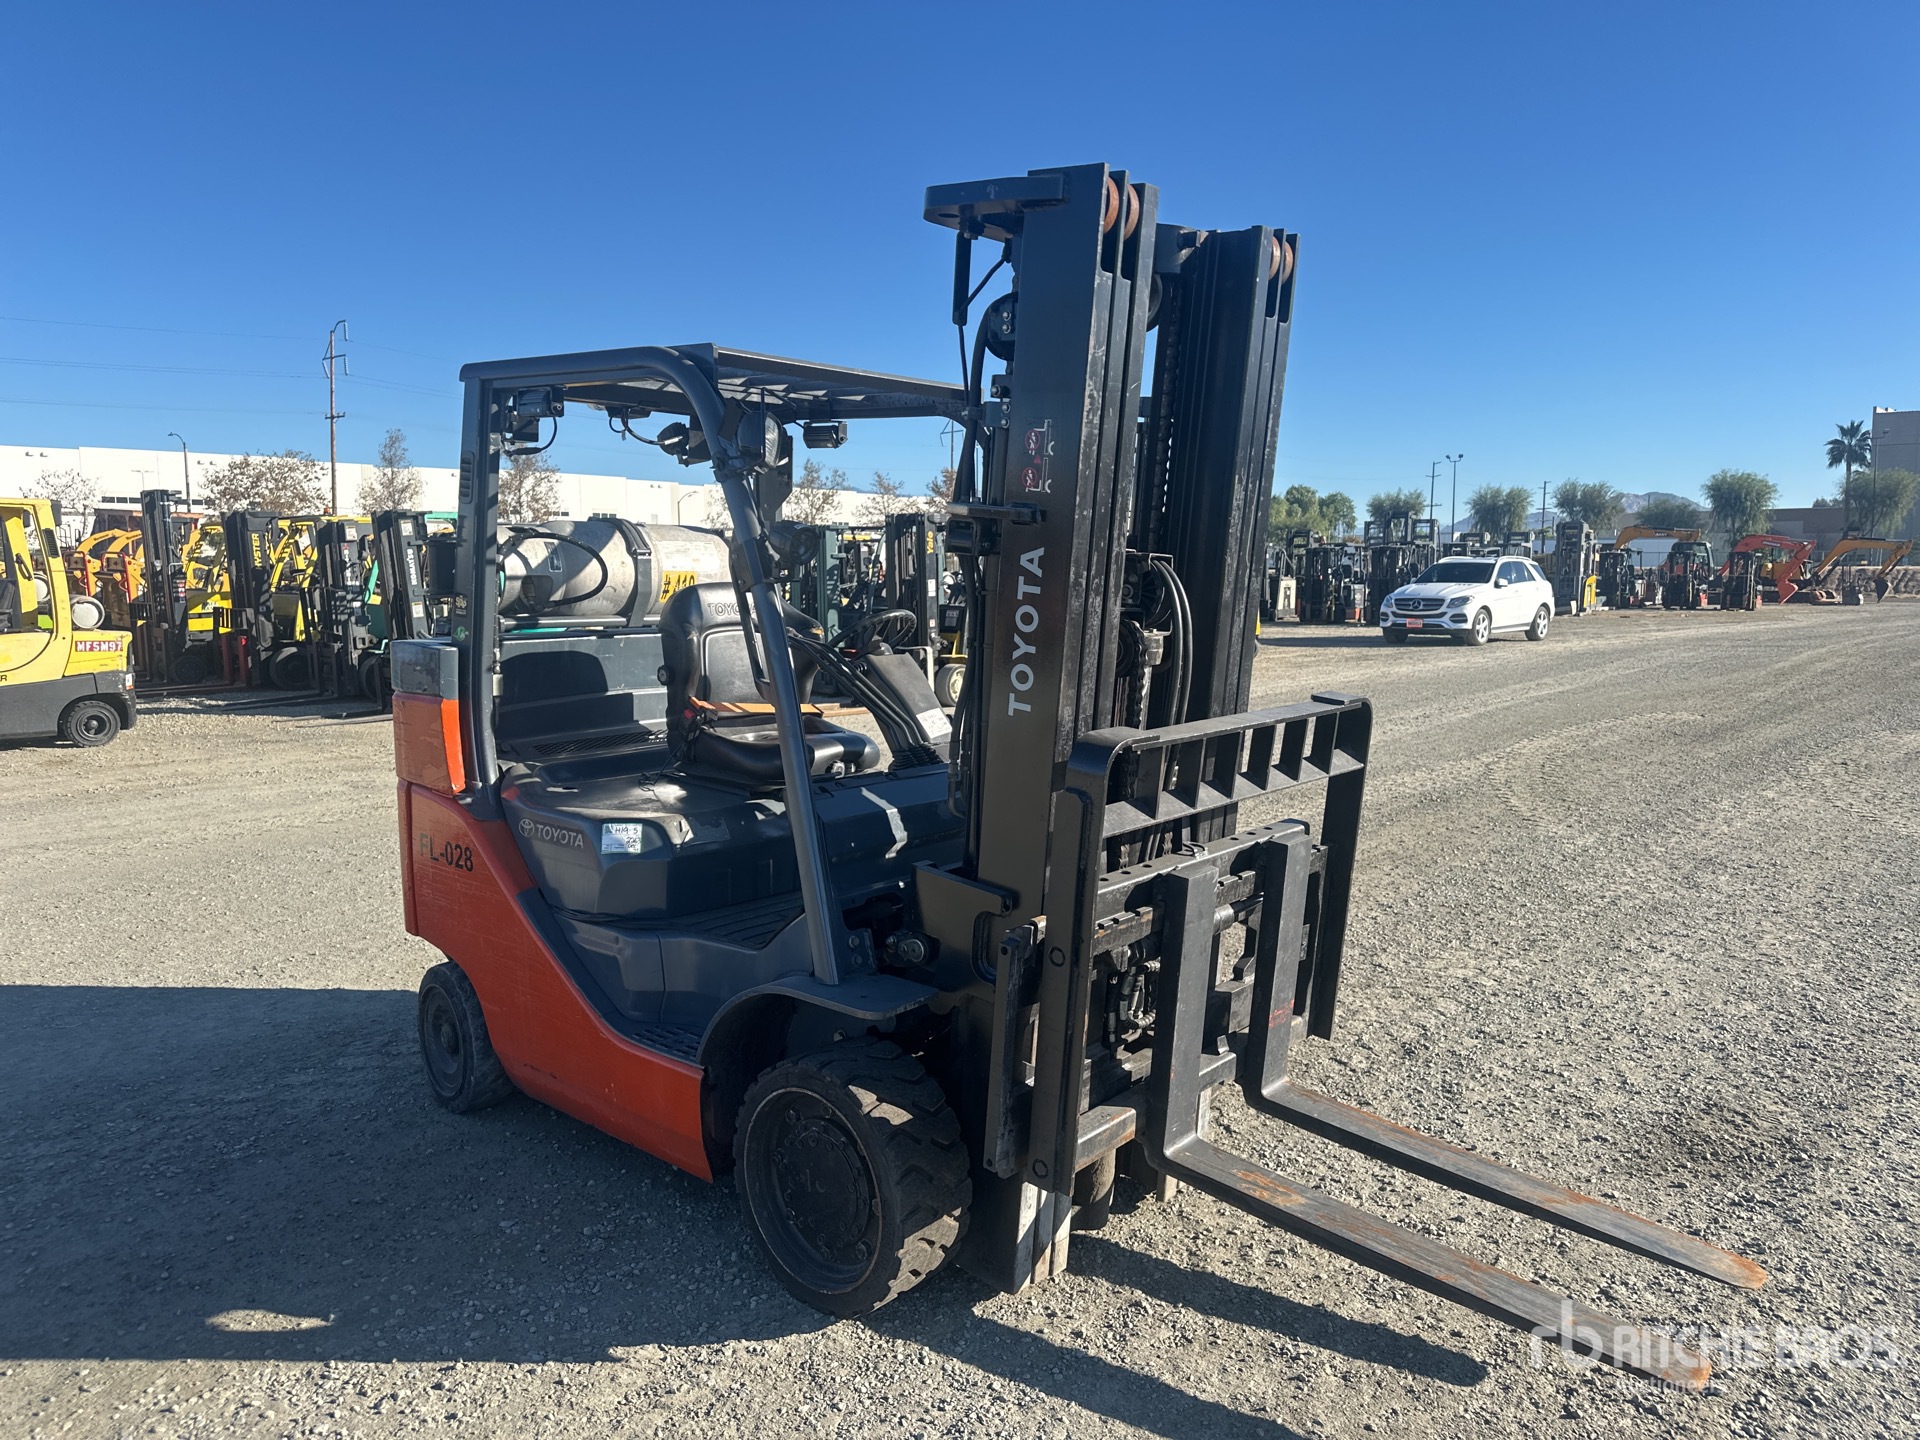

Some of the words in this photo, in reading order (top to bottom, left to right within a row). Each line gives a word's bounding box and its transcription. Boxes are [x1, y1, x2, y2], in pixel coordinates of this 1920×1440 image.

[251, 533, 263, 569] HYSTER
[926, 530, 935, 554] Yale
[406, 548, 418, 586] KOMATSU
[76, 641, 122, 652] MF5M97
[1007, 547, 1045, 717] TOYOTA
[420, 832, 474, 872] FL-028
[536, 824, 584, 849] TOYOTA
